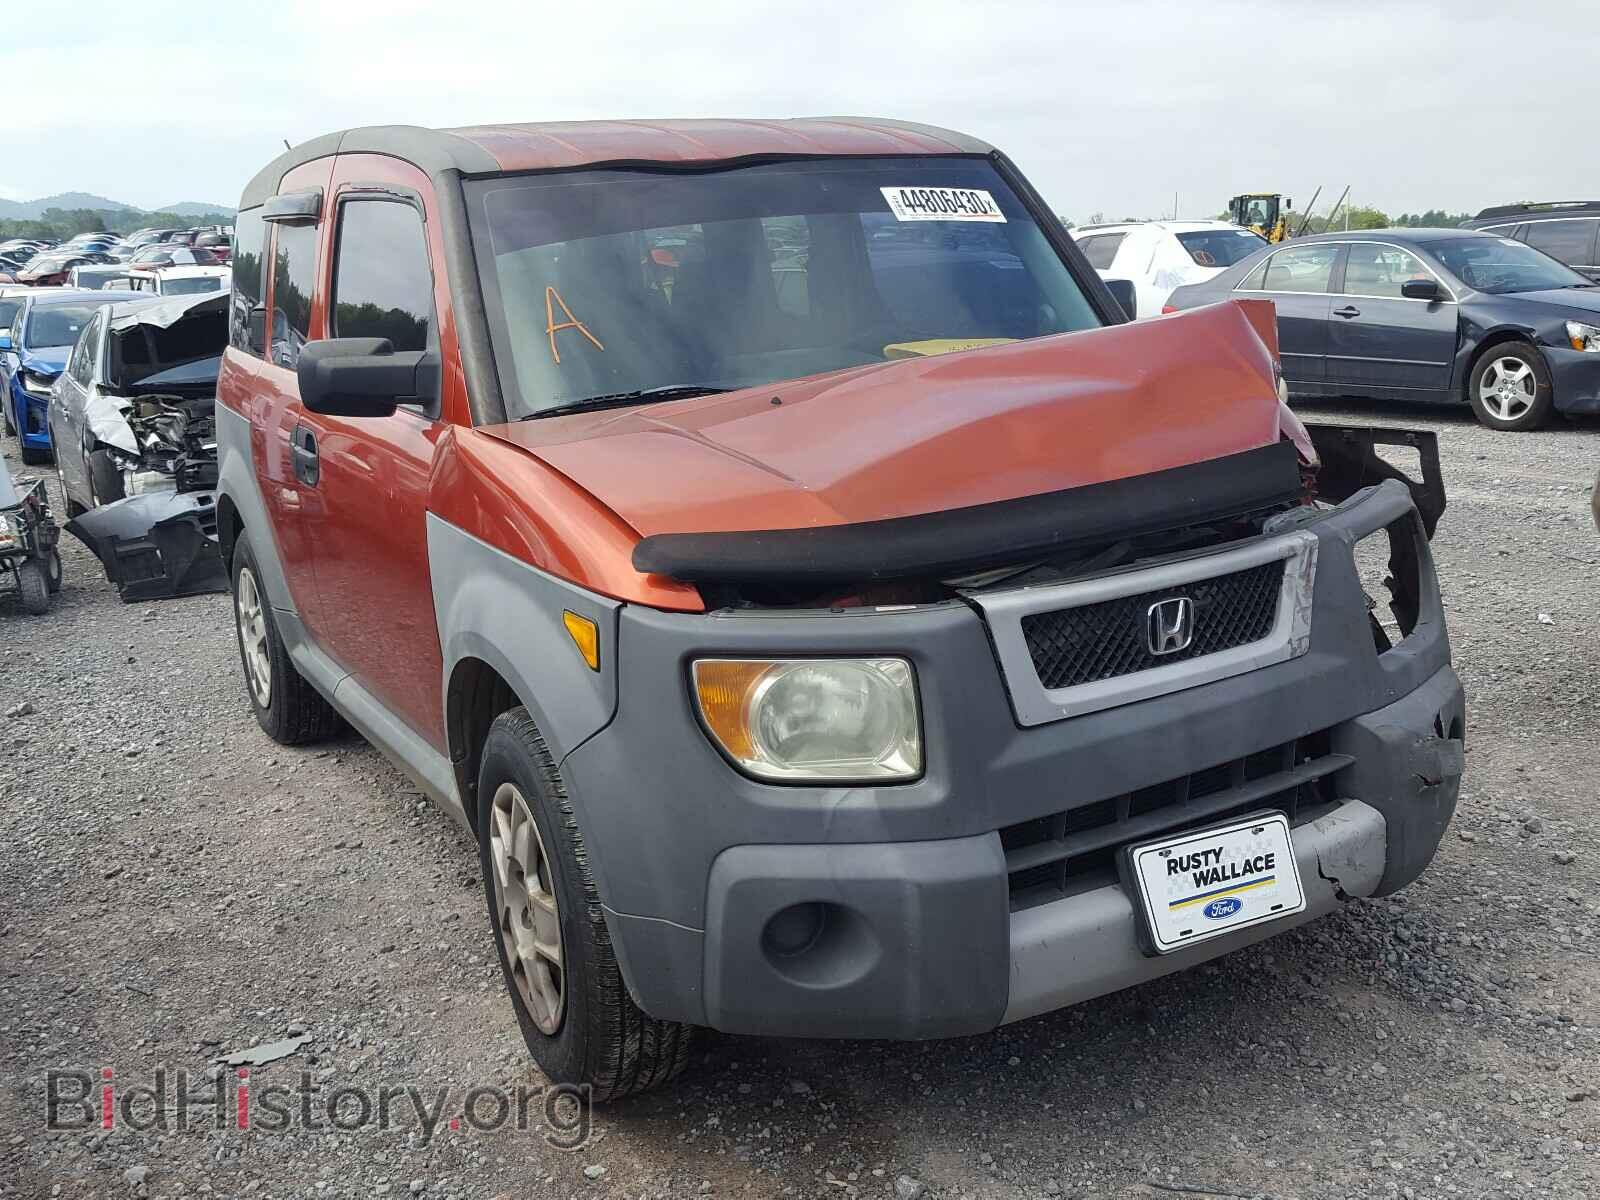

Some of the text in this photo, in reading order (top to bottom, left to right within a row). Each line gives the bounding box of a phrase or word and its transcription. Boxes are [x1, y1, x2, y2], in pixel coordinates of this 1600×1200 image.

[900, 189, 988, 214] 44806430
[545, 286, 605, 364] A
[1166, 846, 1224, 876] RUSTY
[1192, 852, 1276, 889] WALLACE
[1210, 899, 1236, 918] Ford
